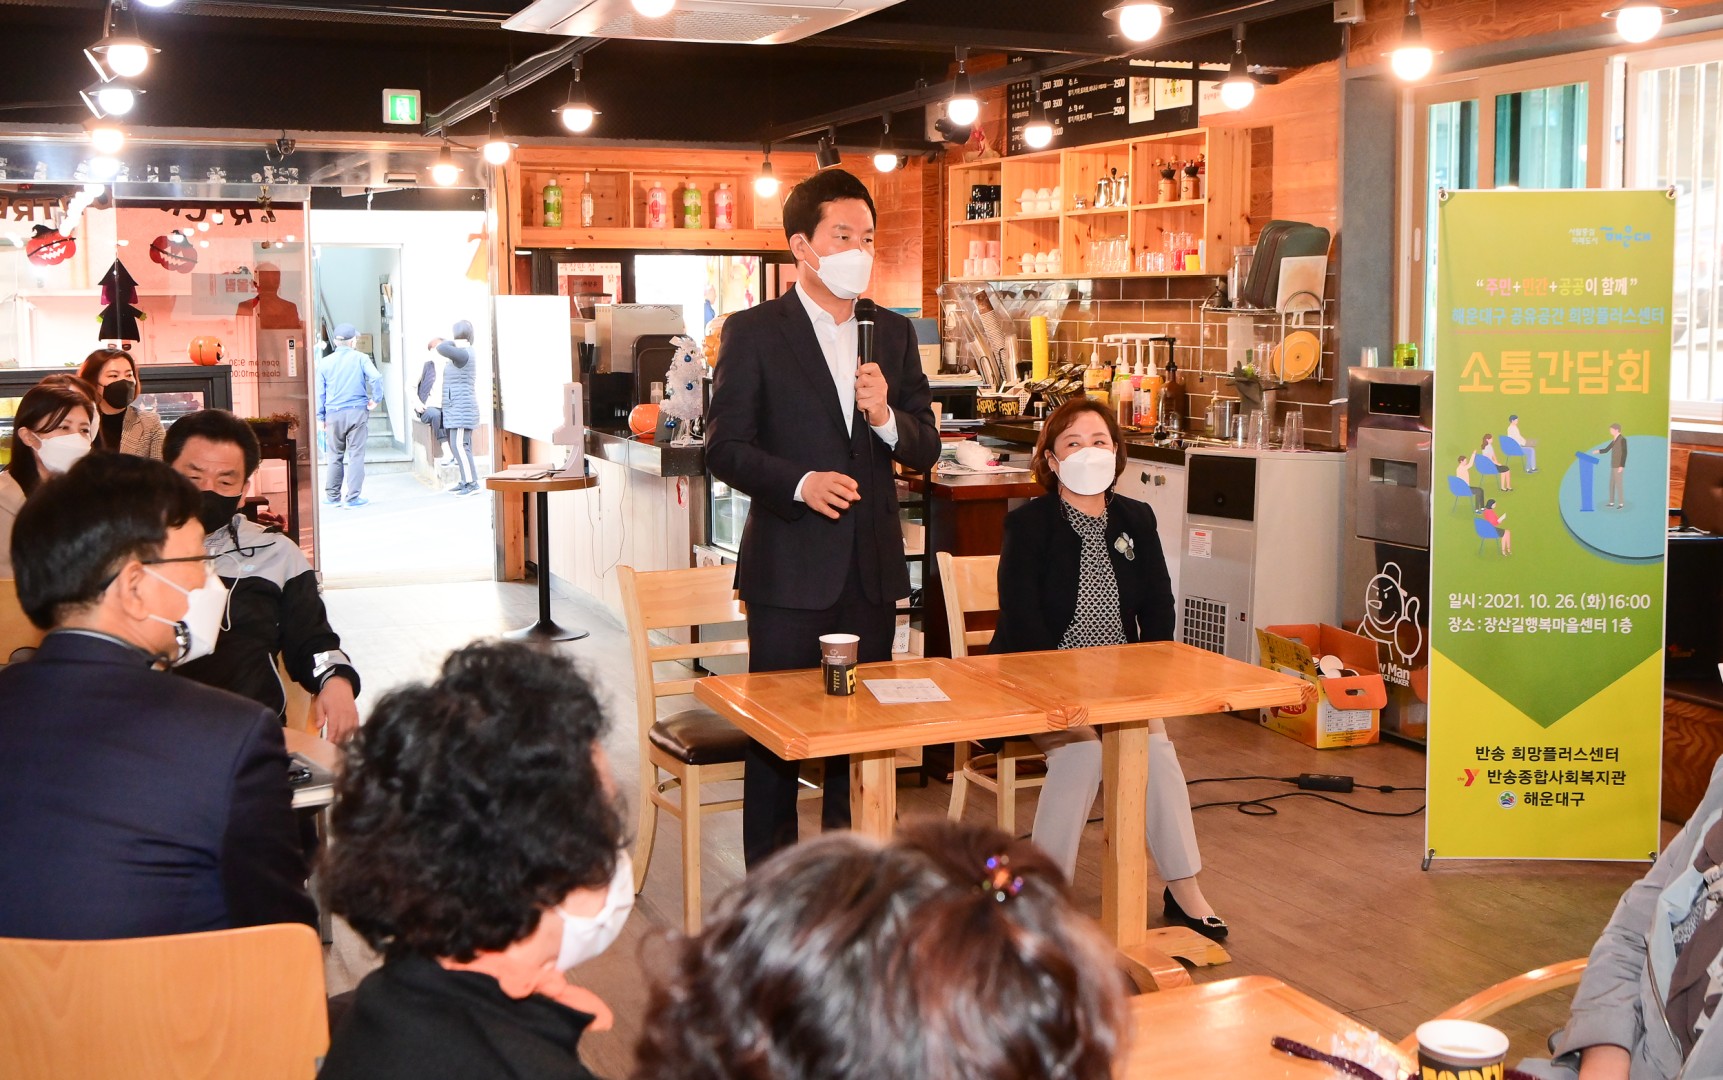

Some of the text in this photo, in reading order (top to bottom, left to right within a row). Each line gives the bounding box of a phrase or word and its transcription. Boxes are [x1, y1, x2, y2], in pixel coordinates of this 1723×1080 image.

[1452, 307, 1664, 326] 해운대구 공유공간 희망플러스센터
[1459, 348, 1650, 395] 소통간담회
[1529, 594, 1550, 609] 10.
[1612, 616, 1633, 634] 1층
[1387, 662, 1410, 681] Man
[1390, 675, 1410, 688] MAKER
[1475, 746, 1619, 762] 반송 희망플러스센터
[1487, 769, 1627, 786] 반송종합사회복지관
[1524, 791, 1586, 807] 해운대구
